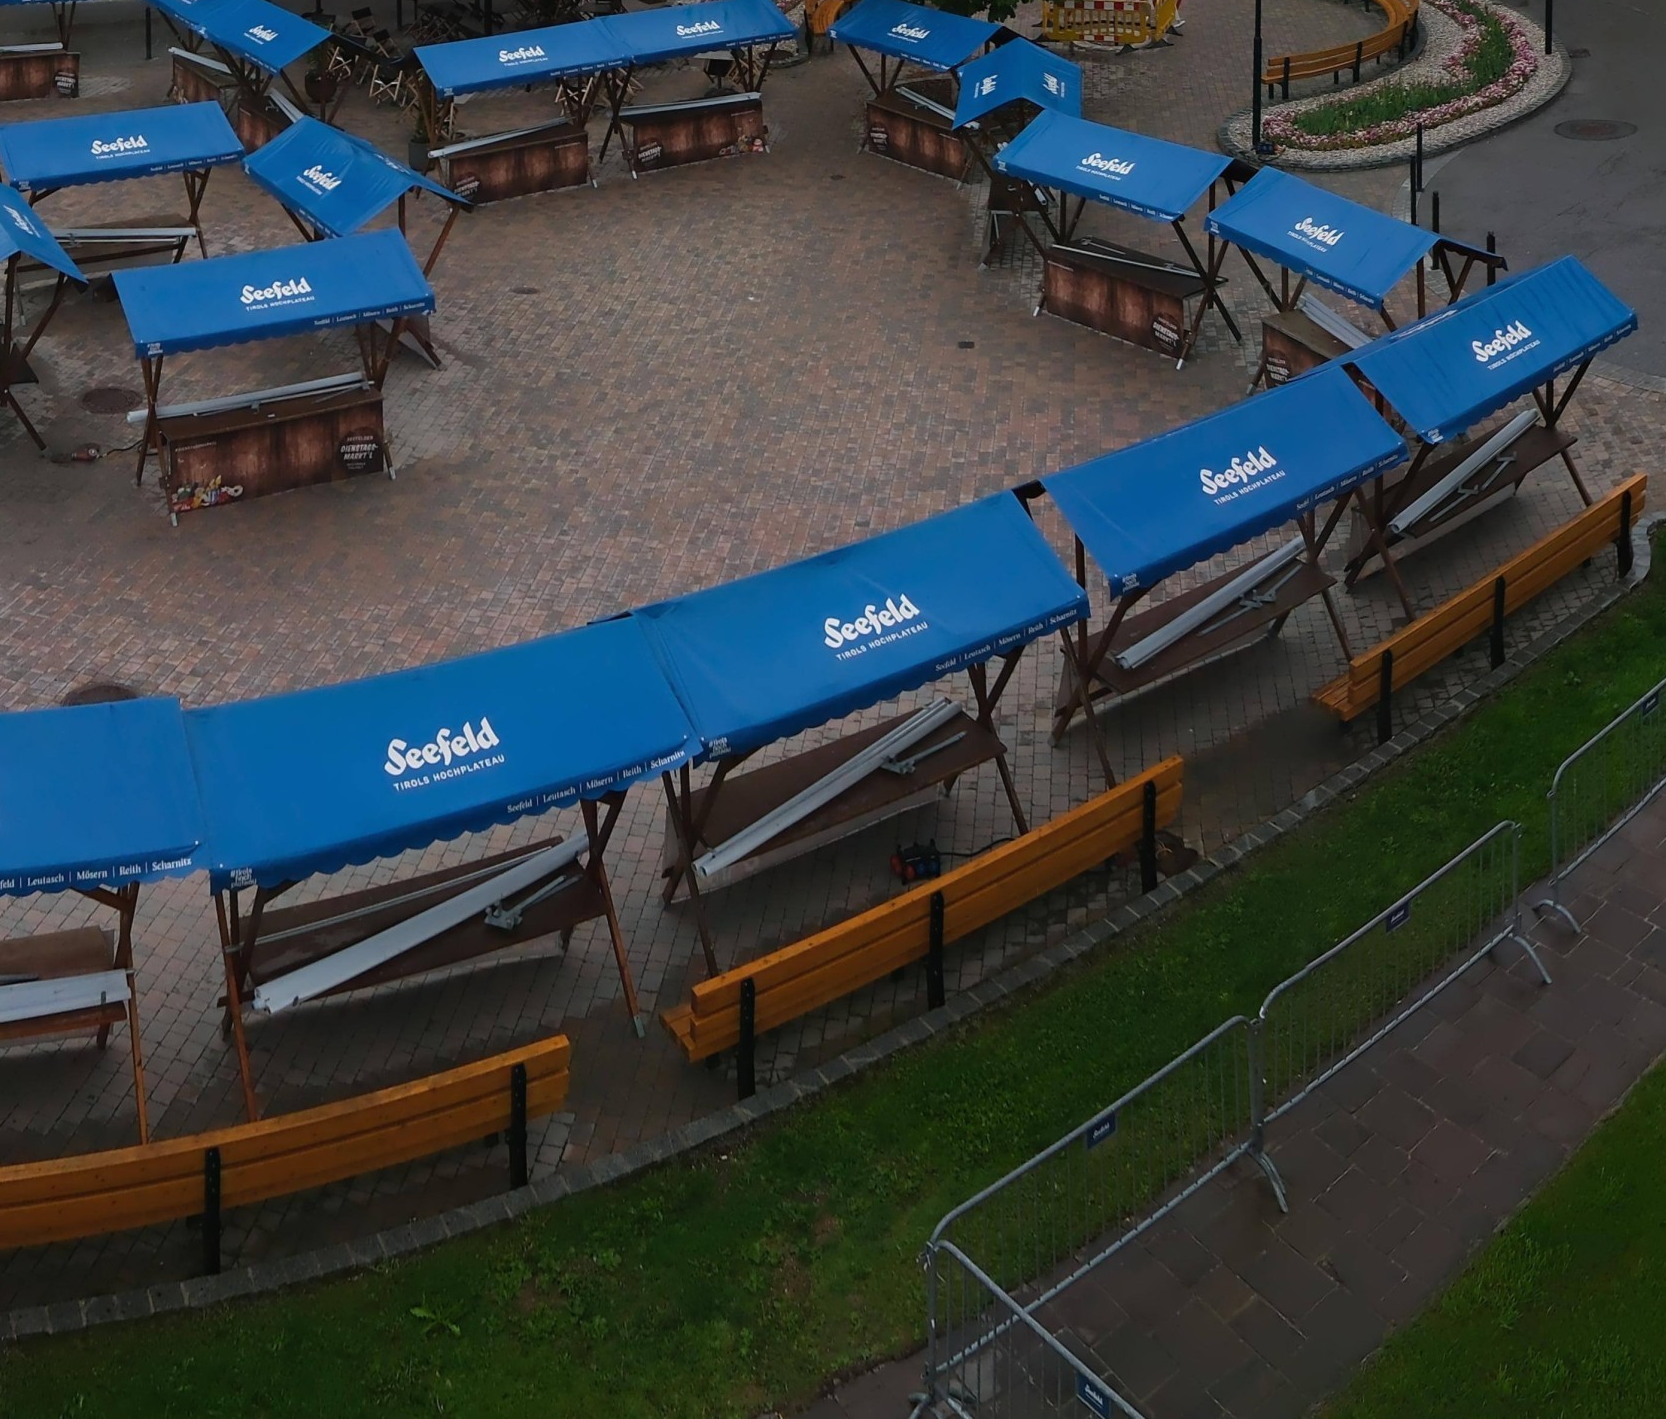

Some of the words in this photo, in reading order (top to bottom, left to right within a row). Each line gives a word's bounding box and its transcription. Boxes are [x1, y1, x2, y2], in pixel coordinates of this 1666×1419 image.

[677, 20, 720, 36] Seefeld
[498, 45, 545, 62] Seefeld
[91, 134, 148, 155] Seefeld
[1081, 152, 1137, 175] Seefeld
[1294, 216, 1345, 247] Seefeld
[240, 276, 312, 304] Seefeld
[1472, 319, 1532, 365] Seefeld
[1200, 445, 1277, 496] Seefeld
[1213, 489, 1237, 505] TIROLS
[1237, 469, 1286, 495] HOCHPLATEAU
[824, 592, 921, 650] Seefeld
[835, 643, 867, 661] TIROLS
[867, 619, 930, 652] HOCHPLATEAU
[383, 716, 501, 777] Seefeld
[393, 775, 430, 793] TIROLS
[432, 753, 506, 783] HOCHPLATEAU
[506, 797, 533, 815] Seefeld
[542, 785, 577, 804] Leutasch
[585, 774, 614, 791] Mösern
[622, 763, 643, 780] Reith
[649, 748, 686, 770] Scharnitz
[27, 871, 65, 888] Leutasch
[76, 866, 108, 880] Mösern
[119, 861, 142, 877] Reith
[151, 854, 192, 873] Scharnitz
